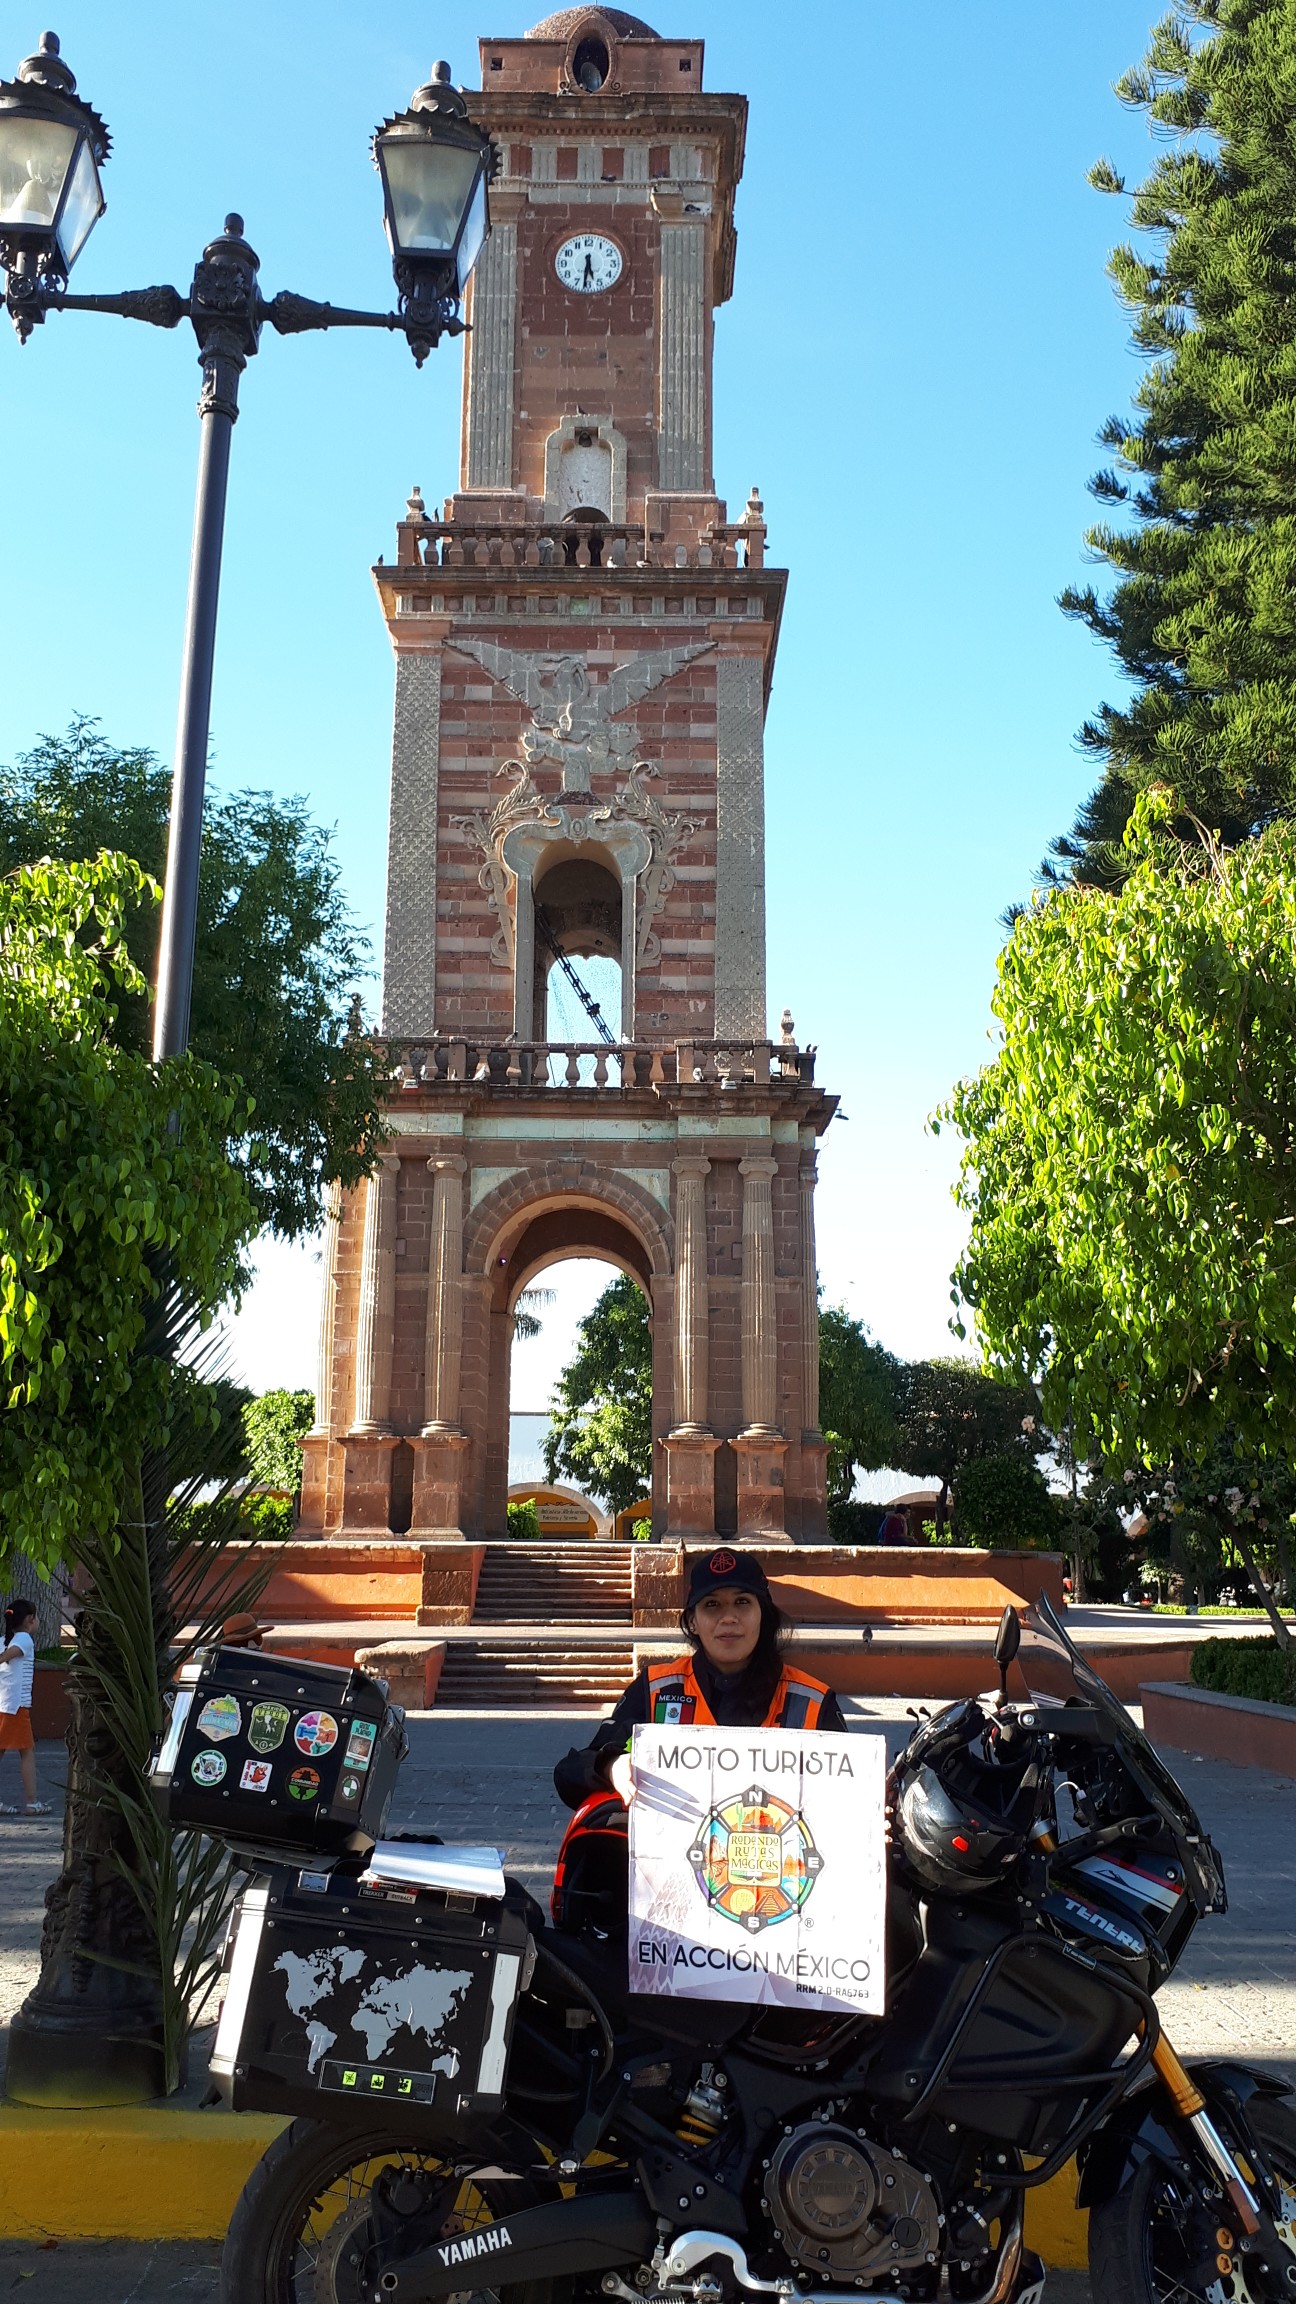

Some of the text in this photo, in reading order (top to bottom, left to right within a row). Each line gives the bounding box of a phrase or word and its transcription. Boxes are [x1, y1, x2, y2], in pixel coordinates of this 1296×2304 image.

[584, 239, 594, 247] 12
[564, 249, 573, 257] 10
[606, 248, 613, 256] 2
[560, 259, 567, 268] 9
[610, 260, 617, 268] 3
[564, 270, 571, 278] 8
[605, 270, 612, 278] 4
[574, 278, 580, 286] 7
[596, 278, 603, 286] 5
[658, 1694, 693, 1703] MEXICO
[658, 1745, 854, 1778] MOTO TURISTA
[748, 1791, 763, 1803] N
[690, 1850, 703, 1861] O
[807, 1857, 820, 1869] E
[362, 1890, 414, 1902] TREKKER OUTBACK
[747, 1917, 760, 1928] S
[638, 1941, 871, 1982] EN ACCIÓN MÉXICO
[796, 1983, 817, 1995] RRM
[438, 2227, 512, 2267] YAMAHA
